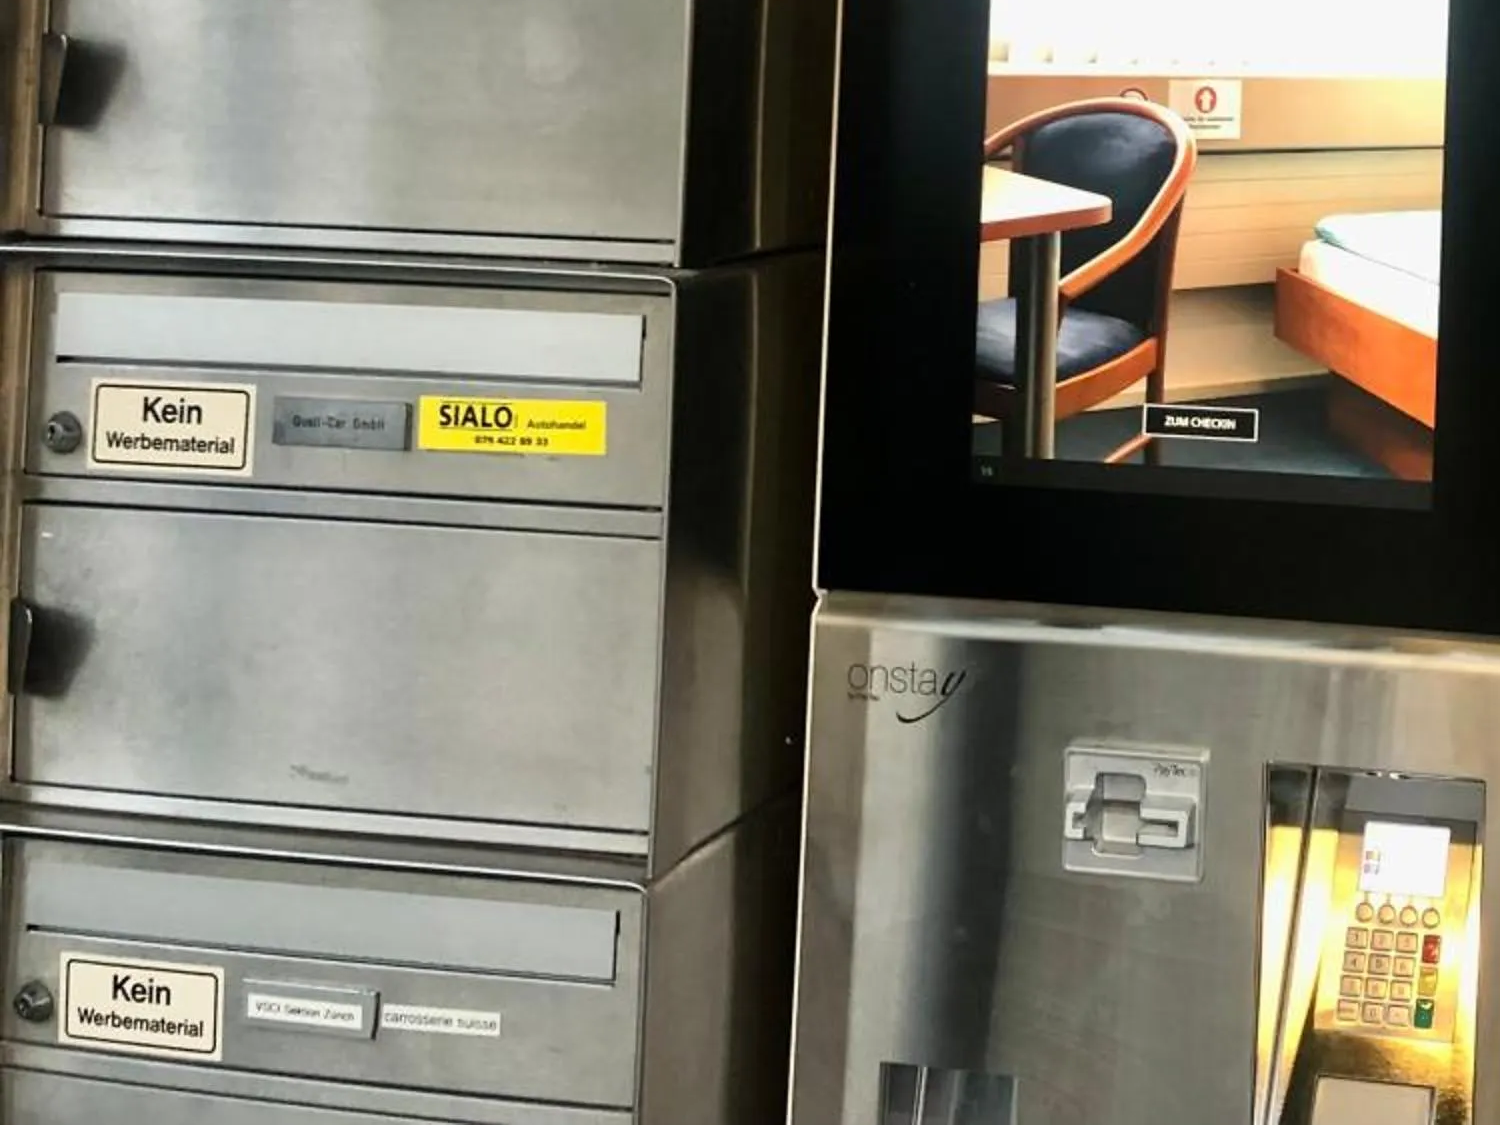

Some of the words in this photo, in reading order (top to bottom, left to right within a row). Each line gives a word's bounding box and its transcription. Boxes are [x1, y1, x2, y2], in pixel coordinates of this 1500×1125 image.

[141, 397, 203, 426] Kein
[439, 403, 514, 429] SIALO
[527, 418, 588, 430] Autohandel
[1164, 415, 1189, 427] ZUM
[105, 432, 235, 455] Werbematerial
[847, 660, 967, 724] onstay
[113, 974, 171, 1006] Kein
[77, 1007, 204, 1038] Werbematerial
[384, 1012, 453, 1027] carrosserie
[457, 1018, 497, 1031] suisse
